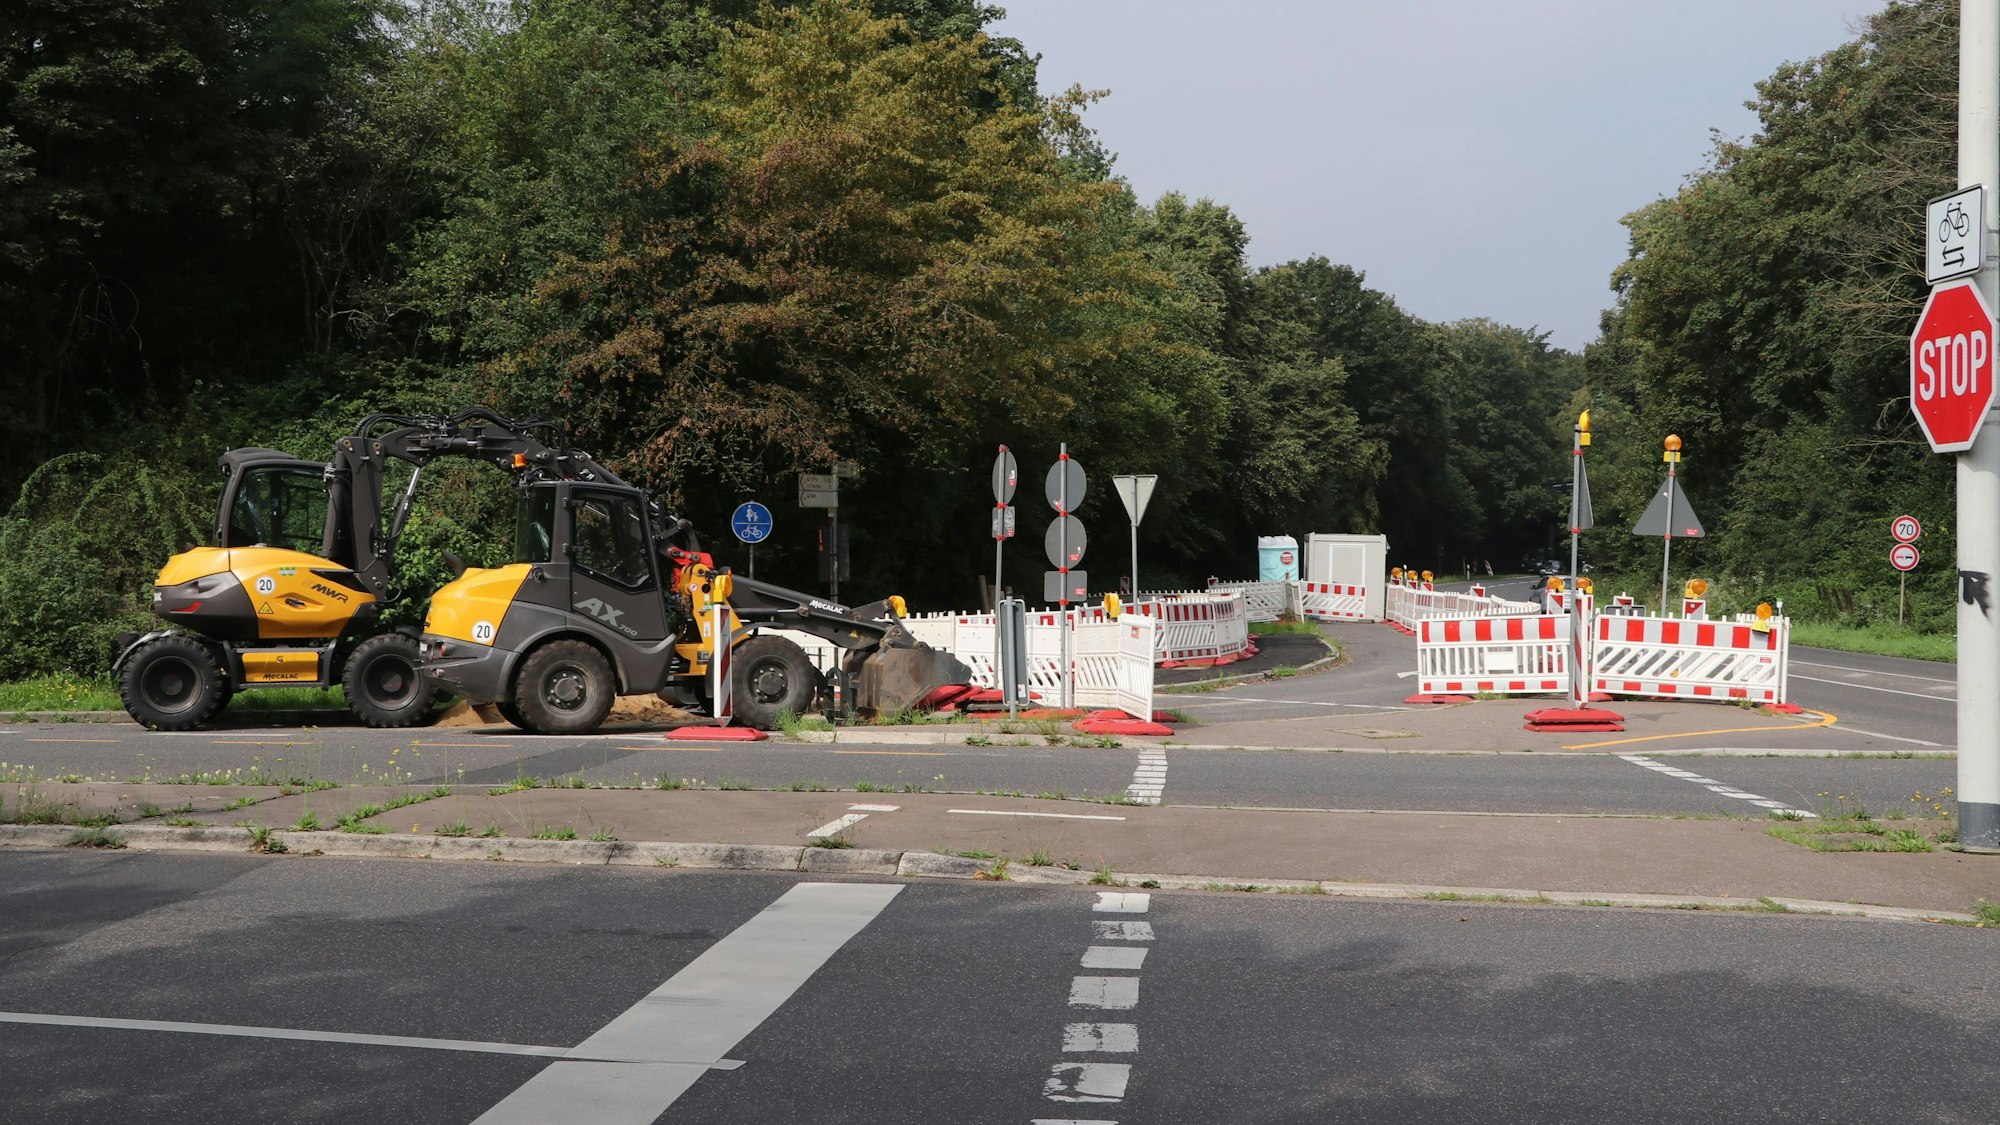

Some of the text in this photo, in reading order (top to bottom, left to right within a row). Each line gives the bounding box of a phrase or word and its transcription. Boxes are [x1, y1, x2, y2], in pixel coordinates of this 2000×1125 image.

[1919, 329, 1987, 401] STOP
[1899, 523, 1914, 536] 70
[259, 579, 273, 591] 20
[573, 597, 639, 637] AX 700
[476, 624, 491, 639] 20
